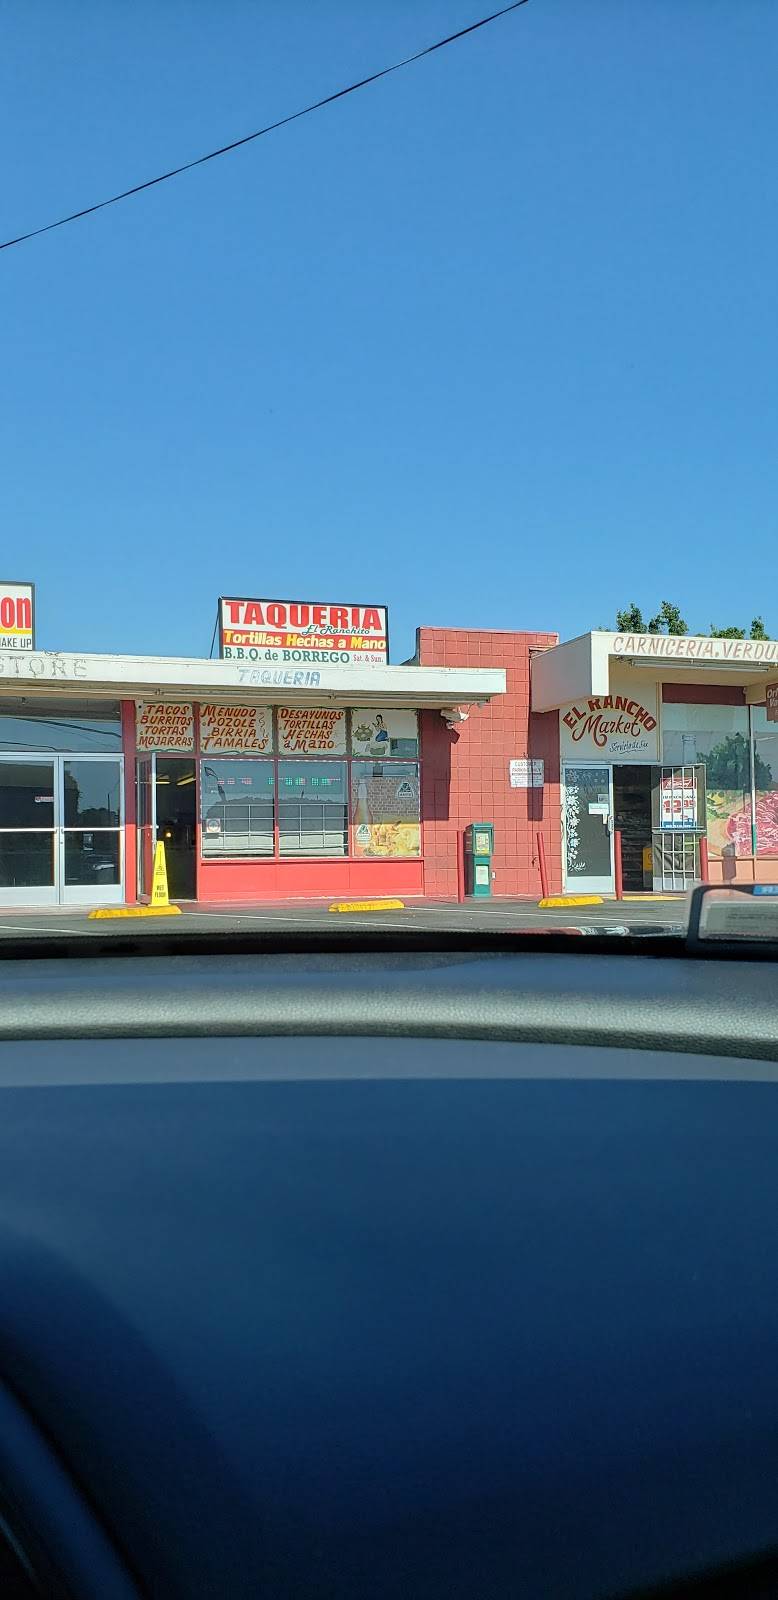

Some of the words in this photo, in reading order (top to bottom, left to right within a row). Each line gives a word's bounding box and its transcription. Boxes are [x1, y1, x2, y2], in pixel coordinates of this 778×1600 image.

[1, 597, 31, 628] on
[225, 601, 382, 630] TAQUERIA
[302, 625, 318, 635] El
[320, 625, 370, 635] Ranchito
[20, 638, 32, 648] UP
[224, 631, 282, 645] Tortillas
[286, 634, 334, 649] Hechas
[338, 639, 346, 649] a
[350, 638, 386, 650] Mano
[225, 647, 262, 661] B.B.Q.
[265, 649, 279, 661] de
[282, 649, 350, 664] BORREGO
[238, 668, 321, 687] TAQUERIA
[146, 705, 189, 715] TACOS
[201, 705, 257, 718] MENUDO
[280, 708, 344, 721] DESAYUNOS
[562, 706, 586, 729] EL
[588, 695, 657, 731] RANCHO
[140, 715, 193, 726] BURRITOS
[207, 717, 257, 728] POZOLE
[283, 720, 336, 730] TORTILLAS
[145, 725, 188, 735] TORTAS
[211, 727, 257, 738] BIRRIA
[283, 730, 332, 740] HECHAS
[572, 714, 641, 748] Market
[139, 736, 193, 748] MOJARRAS
[202, 736, 269, 750] TAMALES
[284, 739, 291, 748] a
[291, 739, 335, 753] Mano
